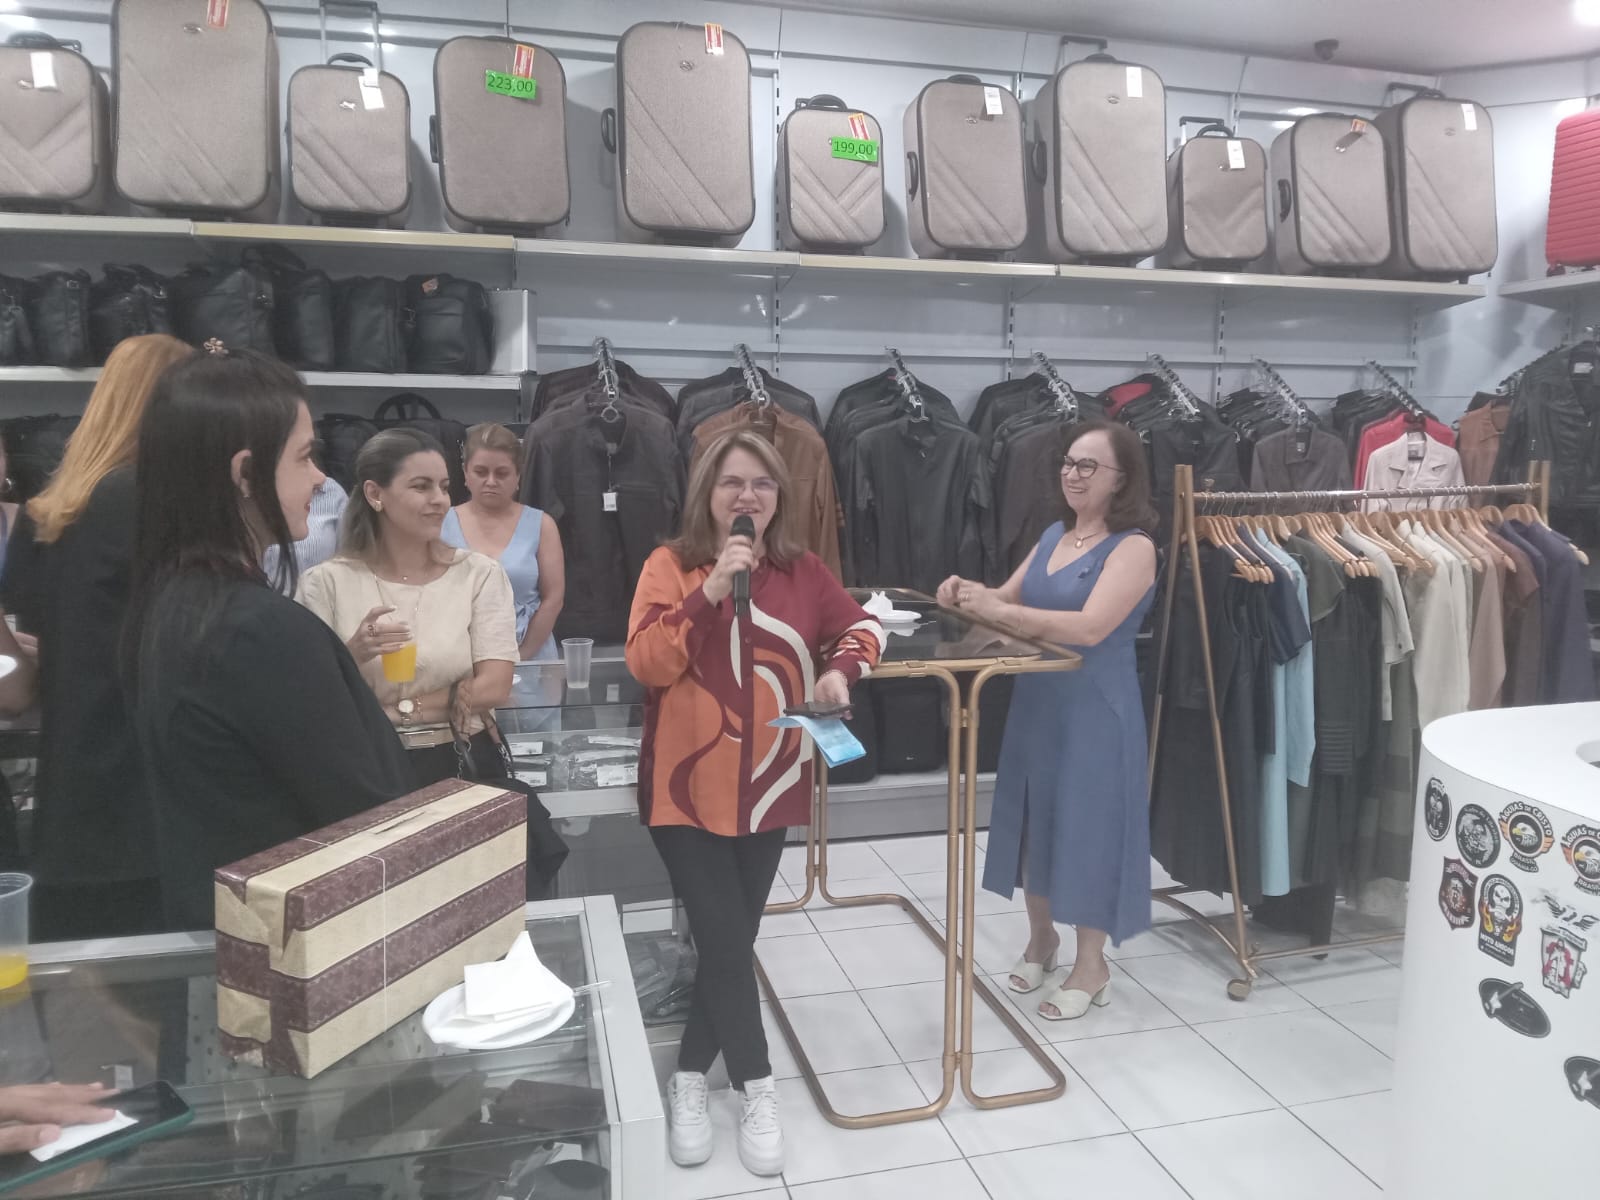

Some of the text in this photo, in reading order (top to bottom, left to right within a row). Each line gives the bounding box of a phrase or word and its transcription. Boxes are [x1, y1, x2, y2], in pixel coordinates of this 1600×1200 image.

[487, 75, 533, 93] 223,00
[833, 141, 874, 156] 199,00
[1532, 807, 1553, 836] CRISTO
